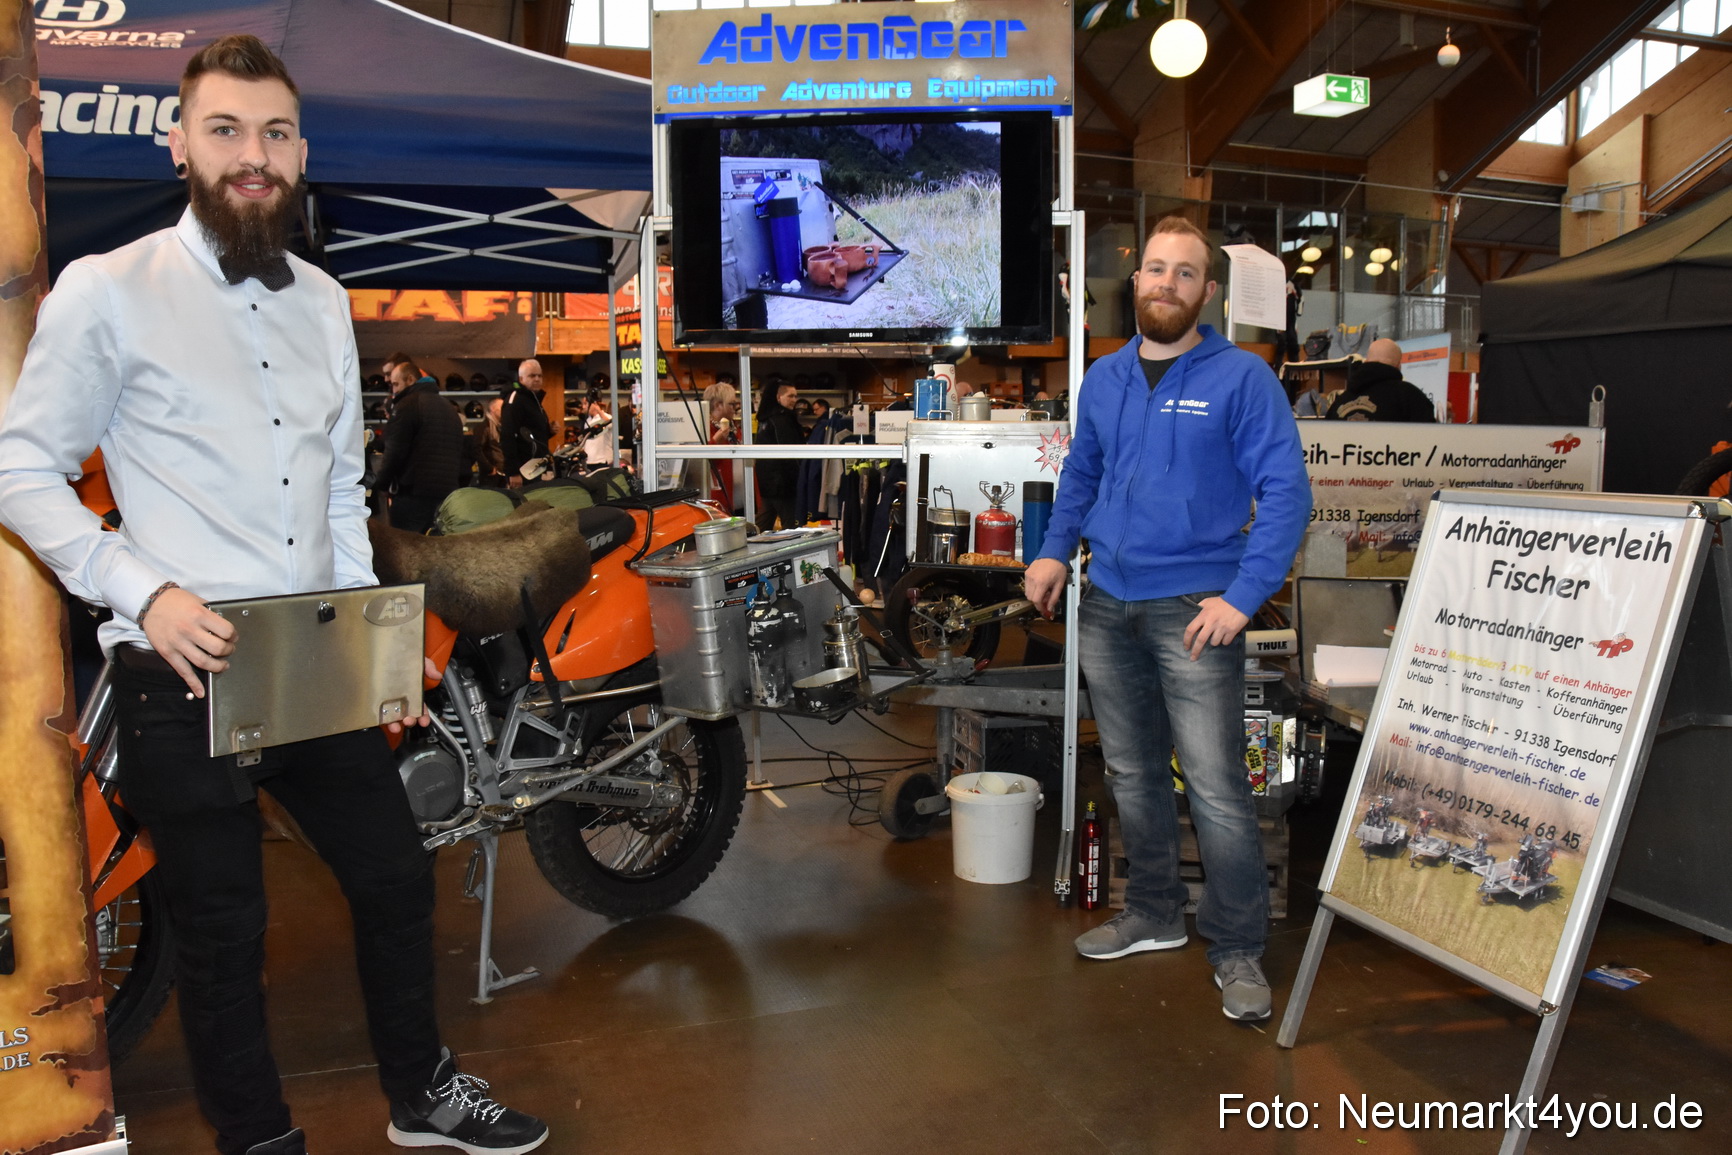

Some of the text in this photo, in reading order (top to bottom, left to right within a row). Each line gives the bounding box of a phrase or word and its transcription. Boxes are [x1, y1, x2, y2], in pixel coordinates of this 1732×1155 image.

[50, 40, 182, 48] MOTORCYCLES
[697, 13, 1027, 65] AdvenGear
[666, 74, 1058, 104] Outdoor Adventure Equipment
[1319, 477, 1344, 487] einen
[1349, 477, 1394, 490] Anhänger
[1402, 477, 1435, 488] Urlaub
[1527, 477, 1584, 491] Überführung
[1441, 453, 1567, 473] Motorradanhänger
[1310, 509, 1421, 526] 91338 Igensdorf
[1359, 531, 1388, 543] Mail:
[1445, 515, 1673, 564] Anhängerverleih
[1486, 559, 1591, 601] Fischer
[1257, 641, 1288, 650] THULE
[1435, 608, 1584, 652] Motorradanhänger
[1410, 657, 1448, 673] Motorrad
[1463, 669, 1483, 681] Auto
[1499, 676, 1531, 693] Kasten
[1546, 687, 1628, 715] Kofferanhänger
[1414, 643, 1426, 654] bis
[1428, 648, 1438, 656] zu
[1441, 649, 1447, 658] 6
[1509, 664, 1533, 677] ATV
[1535, 670, 1550, 681] auf
[1553, 674, 1580, 687] einen
[1584, 680, 1633, 699] Anhänger
[1407, 671, 1434, 685] Urlaub
[1461, 683, 1524, 709] Veranstaltung
[1553, 703, 1623, 734] Überführung
[1390, 733, 1412, 748] Mail:
[1397, 698, 1416, 713] Inh.
[1422, 703, 1459, 723] Werner
[1461, 714, 1499, 735] Fischer
[1514, 728, 1550, 749] 91338
[1553, 739, 1618, 767] Igensdorf
[1383, 770, 1417, 791] Mobil:
[1535, 822, 1556, 841] 68
[1561, 830, 1581, 850] 45
